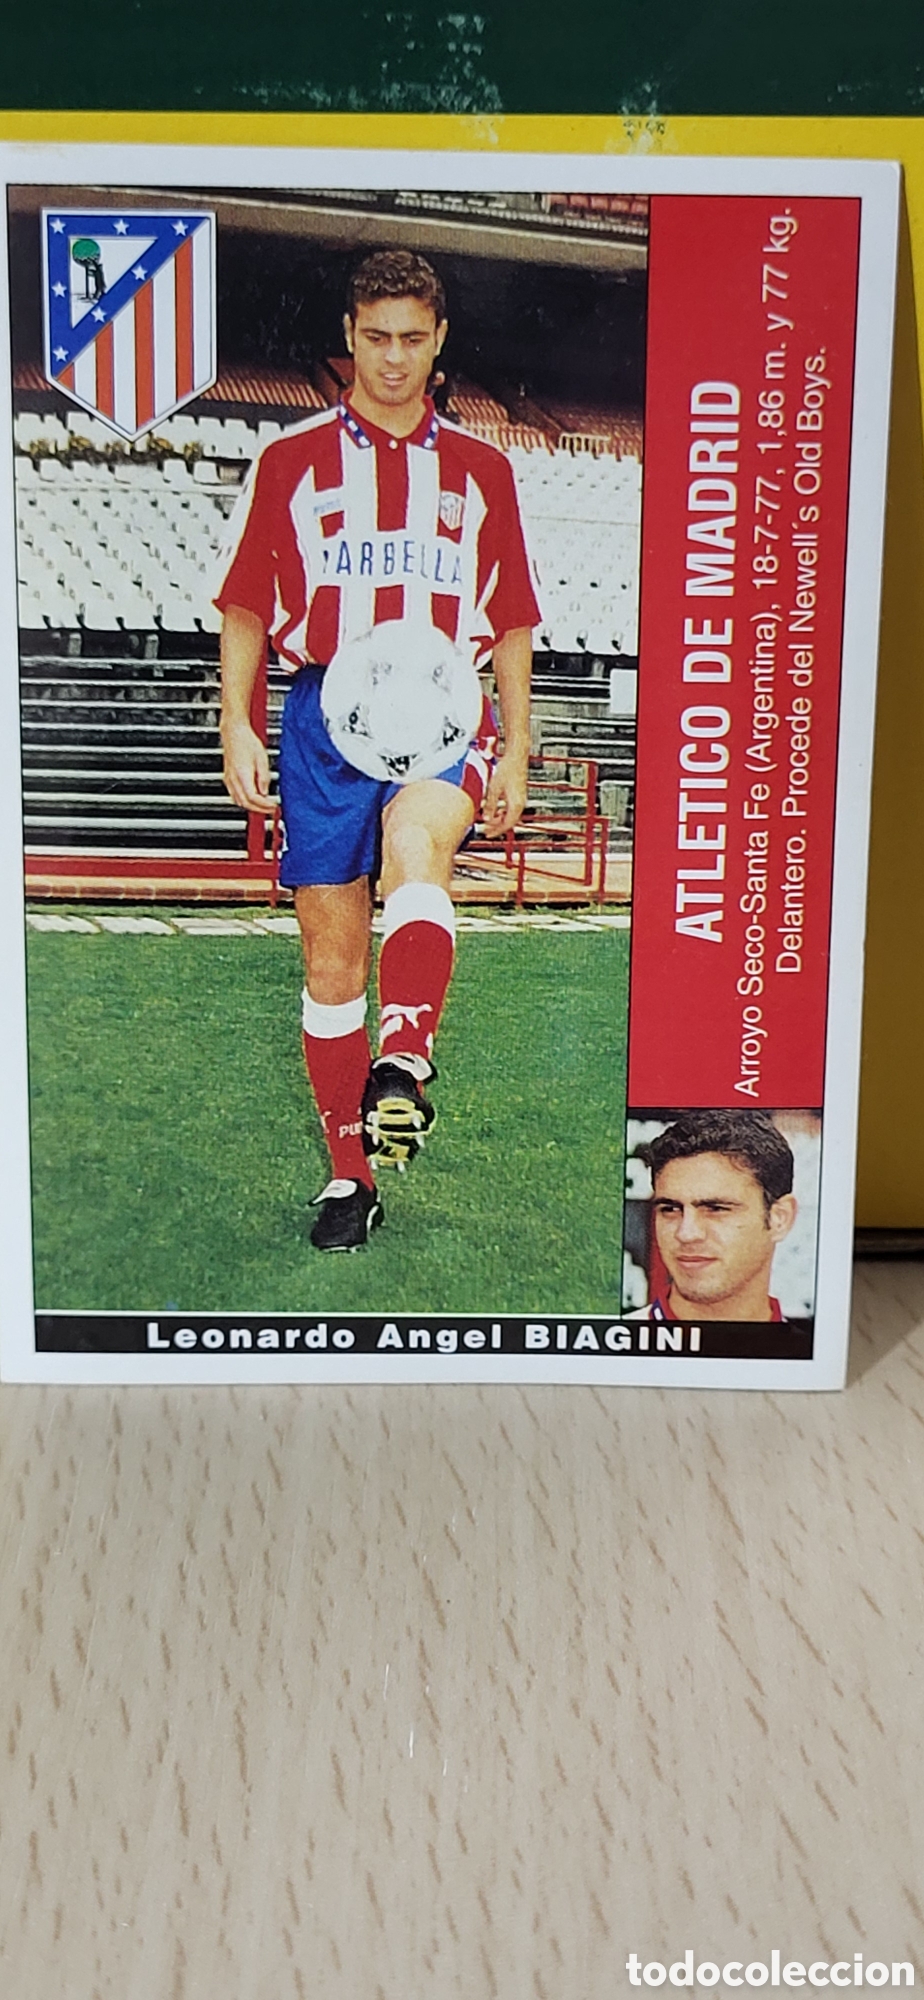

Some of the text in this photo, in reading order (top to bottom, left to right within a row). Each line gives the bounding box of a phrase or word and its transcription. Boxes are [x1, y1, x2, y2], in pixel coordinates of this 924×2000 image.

[796, 348, 831, 431] Boys.
[793, 442, 822, 495] Old
[323, 540, 463, 584] ARBELLA
[675, 381, 741, 943] ATLETICO DE MADRID
[733, 208, 798, 1098] Arroyo Seco-Santa Fe (Argentina), 18-7-77, 1,86 m. y 77 kg.
[786, 644, 814, 687] del
[781, 697, 812, 817] Procede
[775, 829, 807, 973] Delantero.
[146, 1321, 702, 1353] Leonardo Angel BIAGINI
